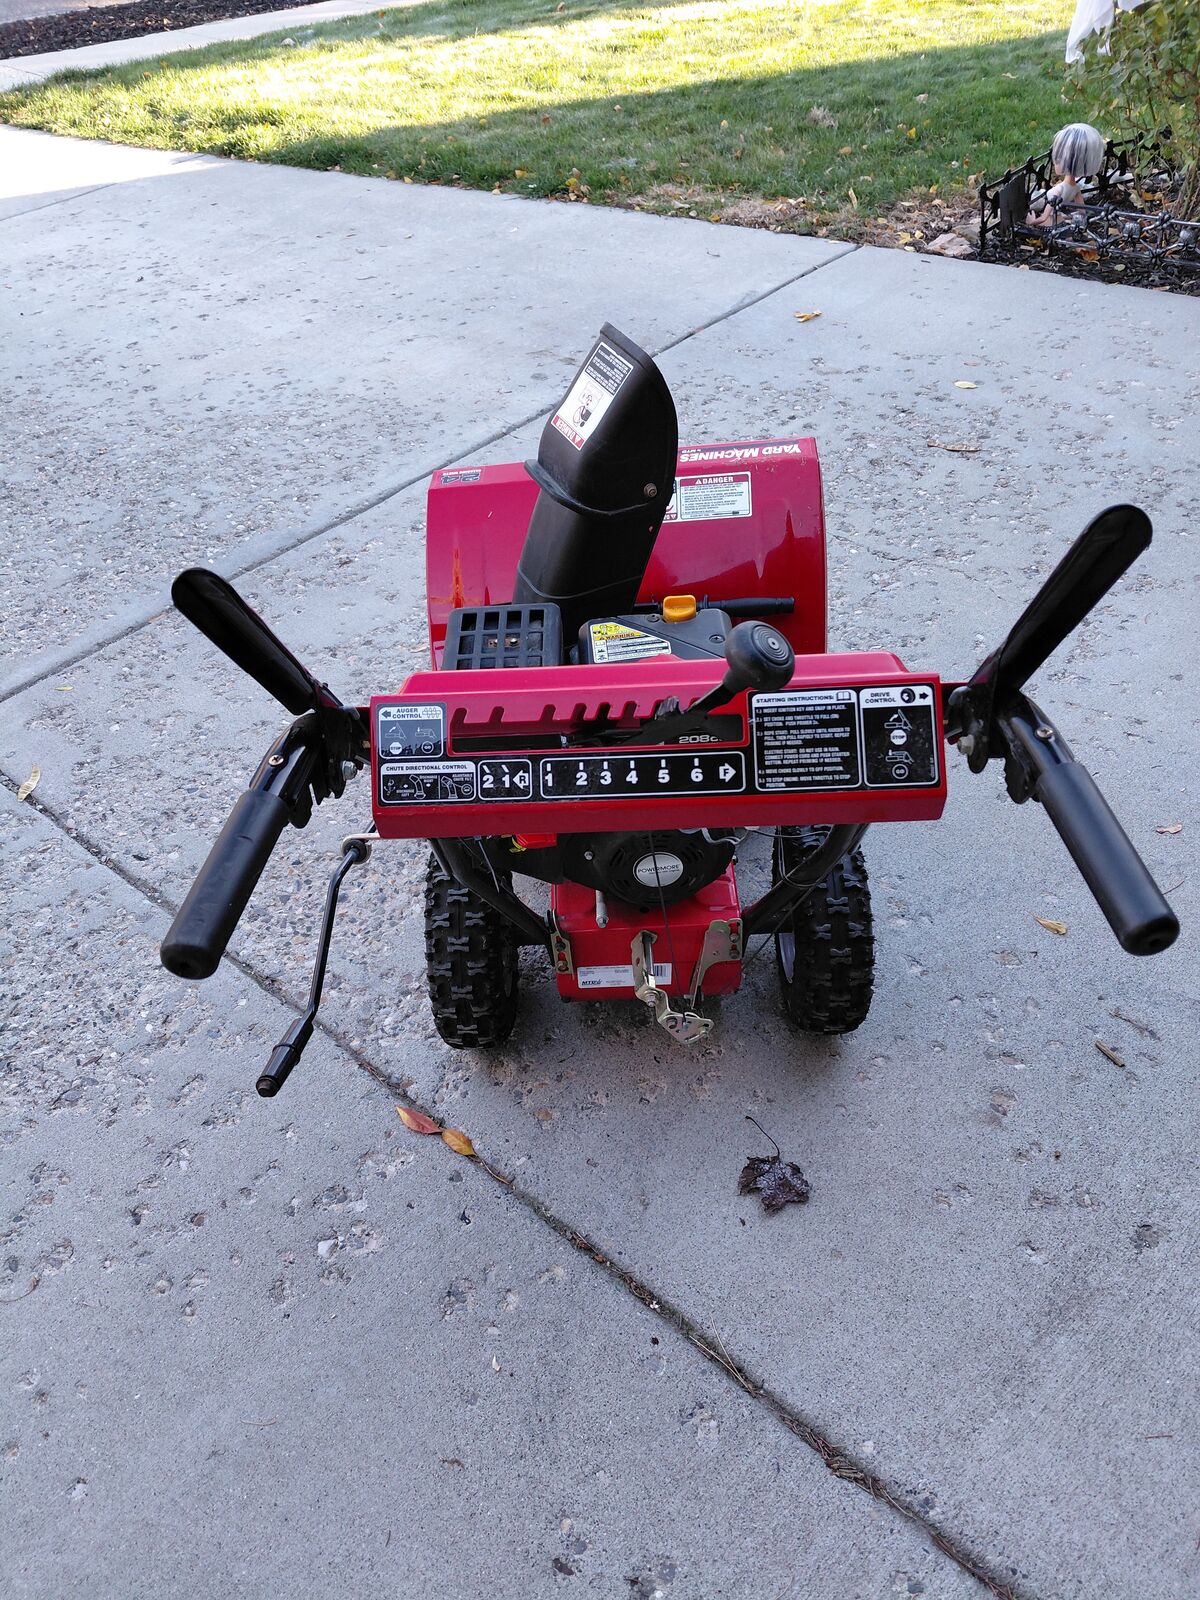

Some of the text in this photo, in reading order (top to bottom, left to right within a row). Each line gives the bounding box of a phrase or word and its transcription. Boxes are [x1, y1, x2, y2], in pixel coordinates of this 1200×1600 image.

[680, 444, 801, 462] YARD MACHINES
[441, 473, 480, 484] 24
[702, 476, 734, 484] DANGER
[679, 735, 722, 743] 208c
[483, 774, 526, 788] 2 1 R
[545, 768, 729, 786] 1 2 3 4 5 6 F
[638, 864, 679, 873] POWERMORE
